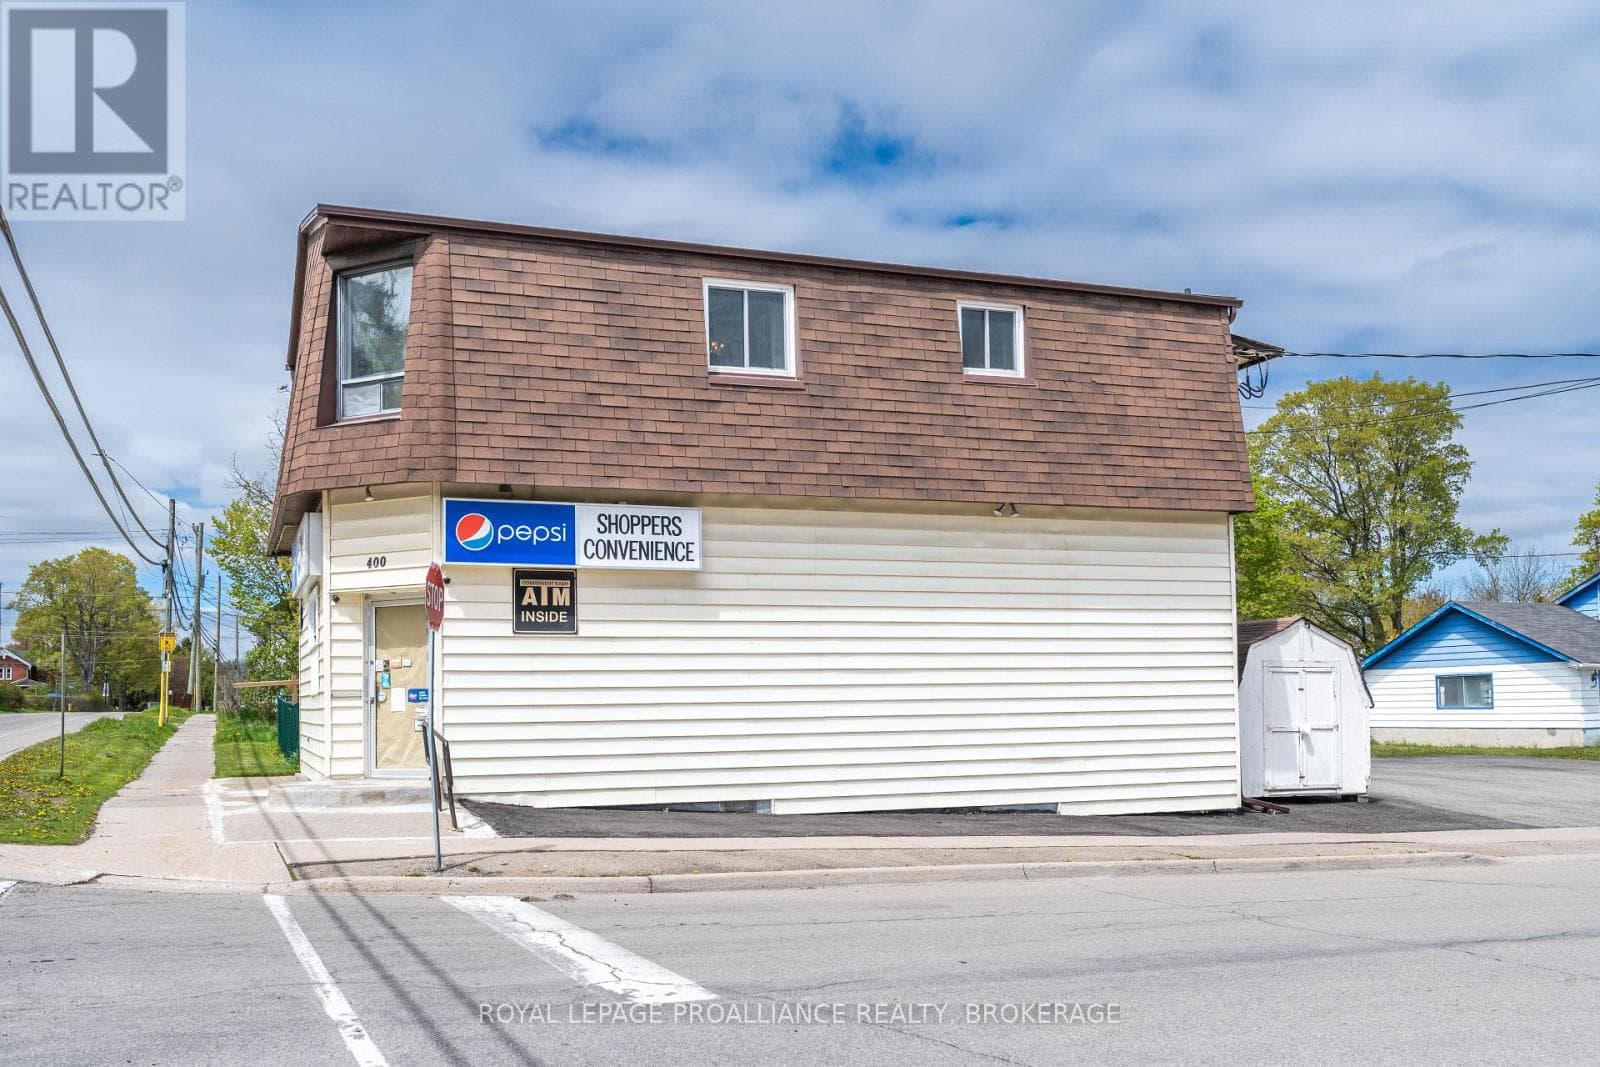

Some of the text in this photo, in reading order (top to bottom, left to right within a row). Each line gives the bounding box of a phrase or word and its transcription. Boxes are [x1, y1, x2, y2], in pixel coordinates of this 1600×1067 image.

[497, 523, 566, 546] pepsi
[597, 513, 682, 536] SHOPPERS
[583, 538, 695, 562] CONVENIENCE
[366, 556, 386, 569] 400
[426, 580, 443, 611] STOP
[521, 585, 570, 606] ATM
[521, 611, 568, 622] INSIDE
